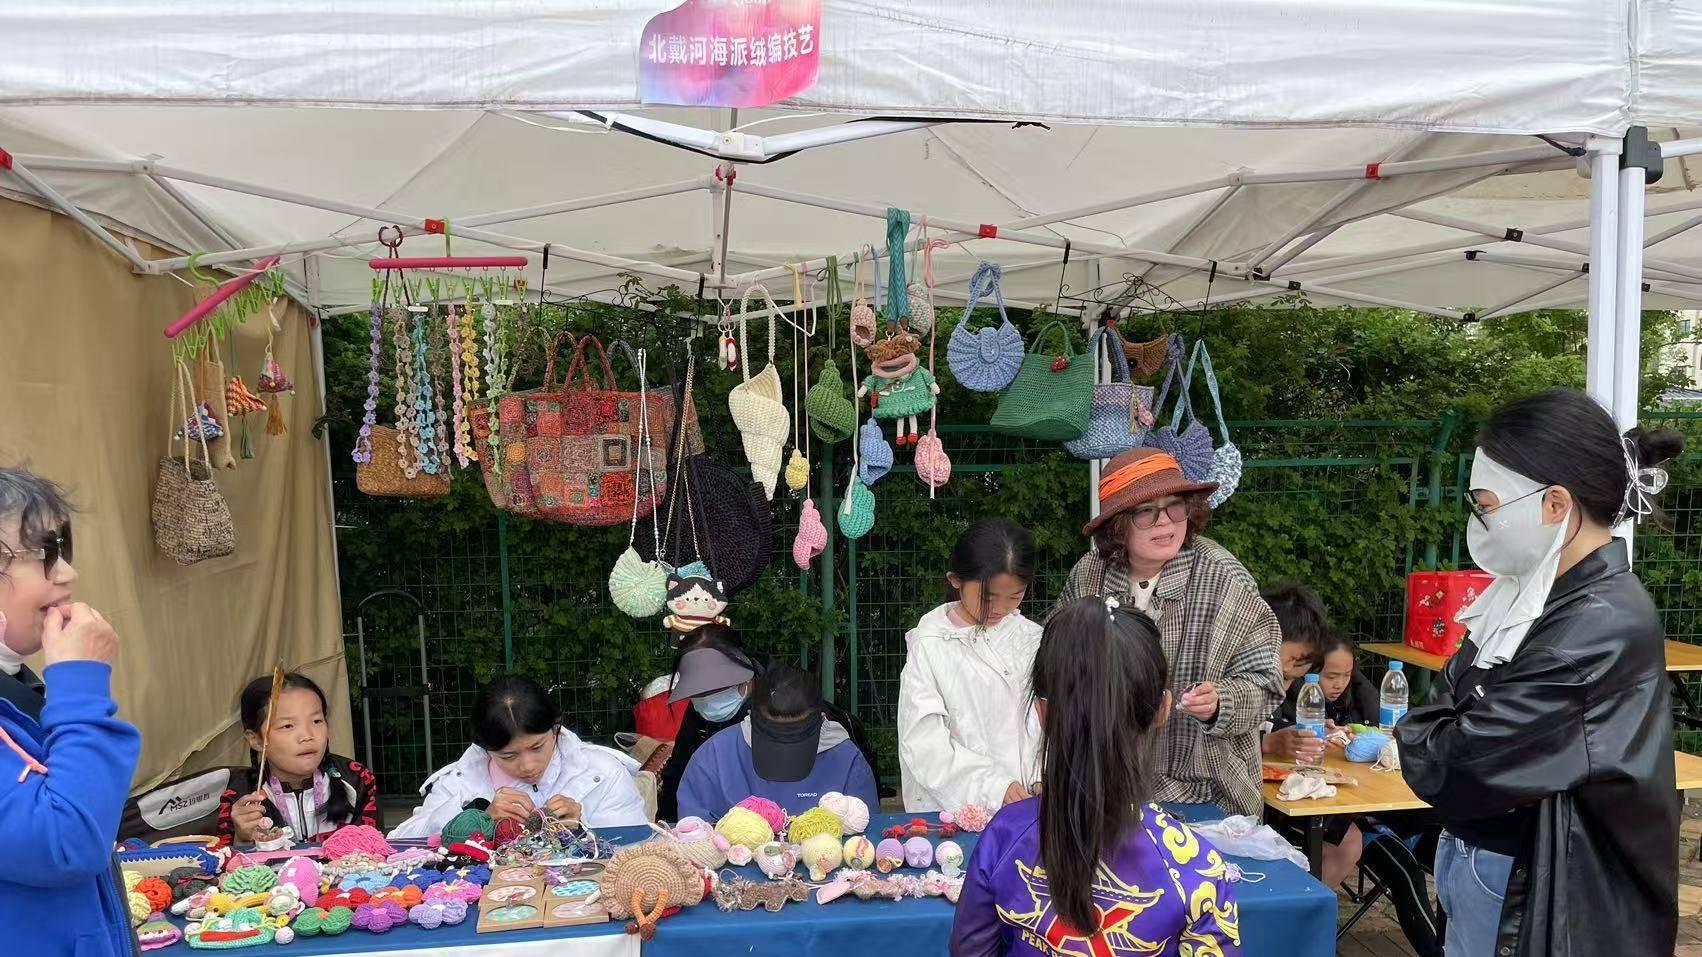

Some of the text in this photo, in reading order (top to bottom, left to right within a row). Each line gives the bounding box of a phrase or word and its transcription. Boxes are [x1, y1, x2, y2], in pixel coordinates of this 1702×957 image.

[648, 24, 814, 66] 北戴河海派绒编技艺
[170, 800, 188, 811] MSZ
[1021, 929, 1050, 956] PEAK
